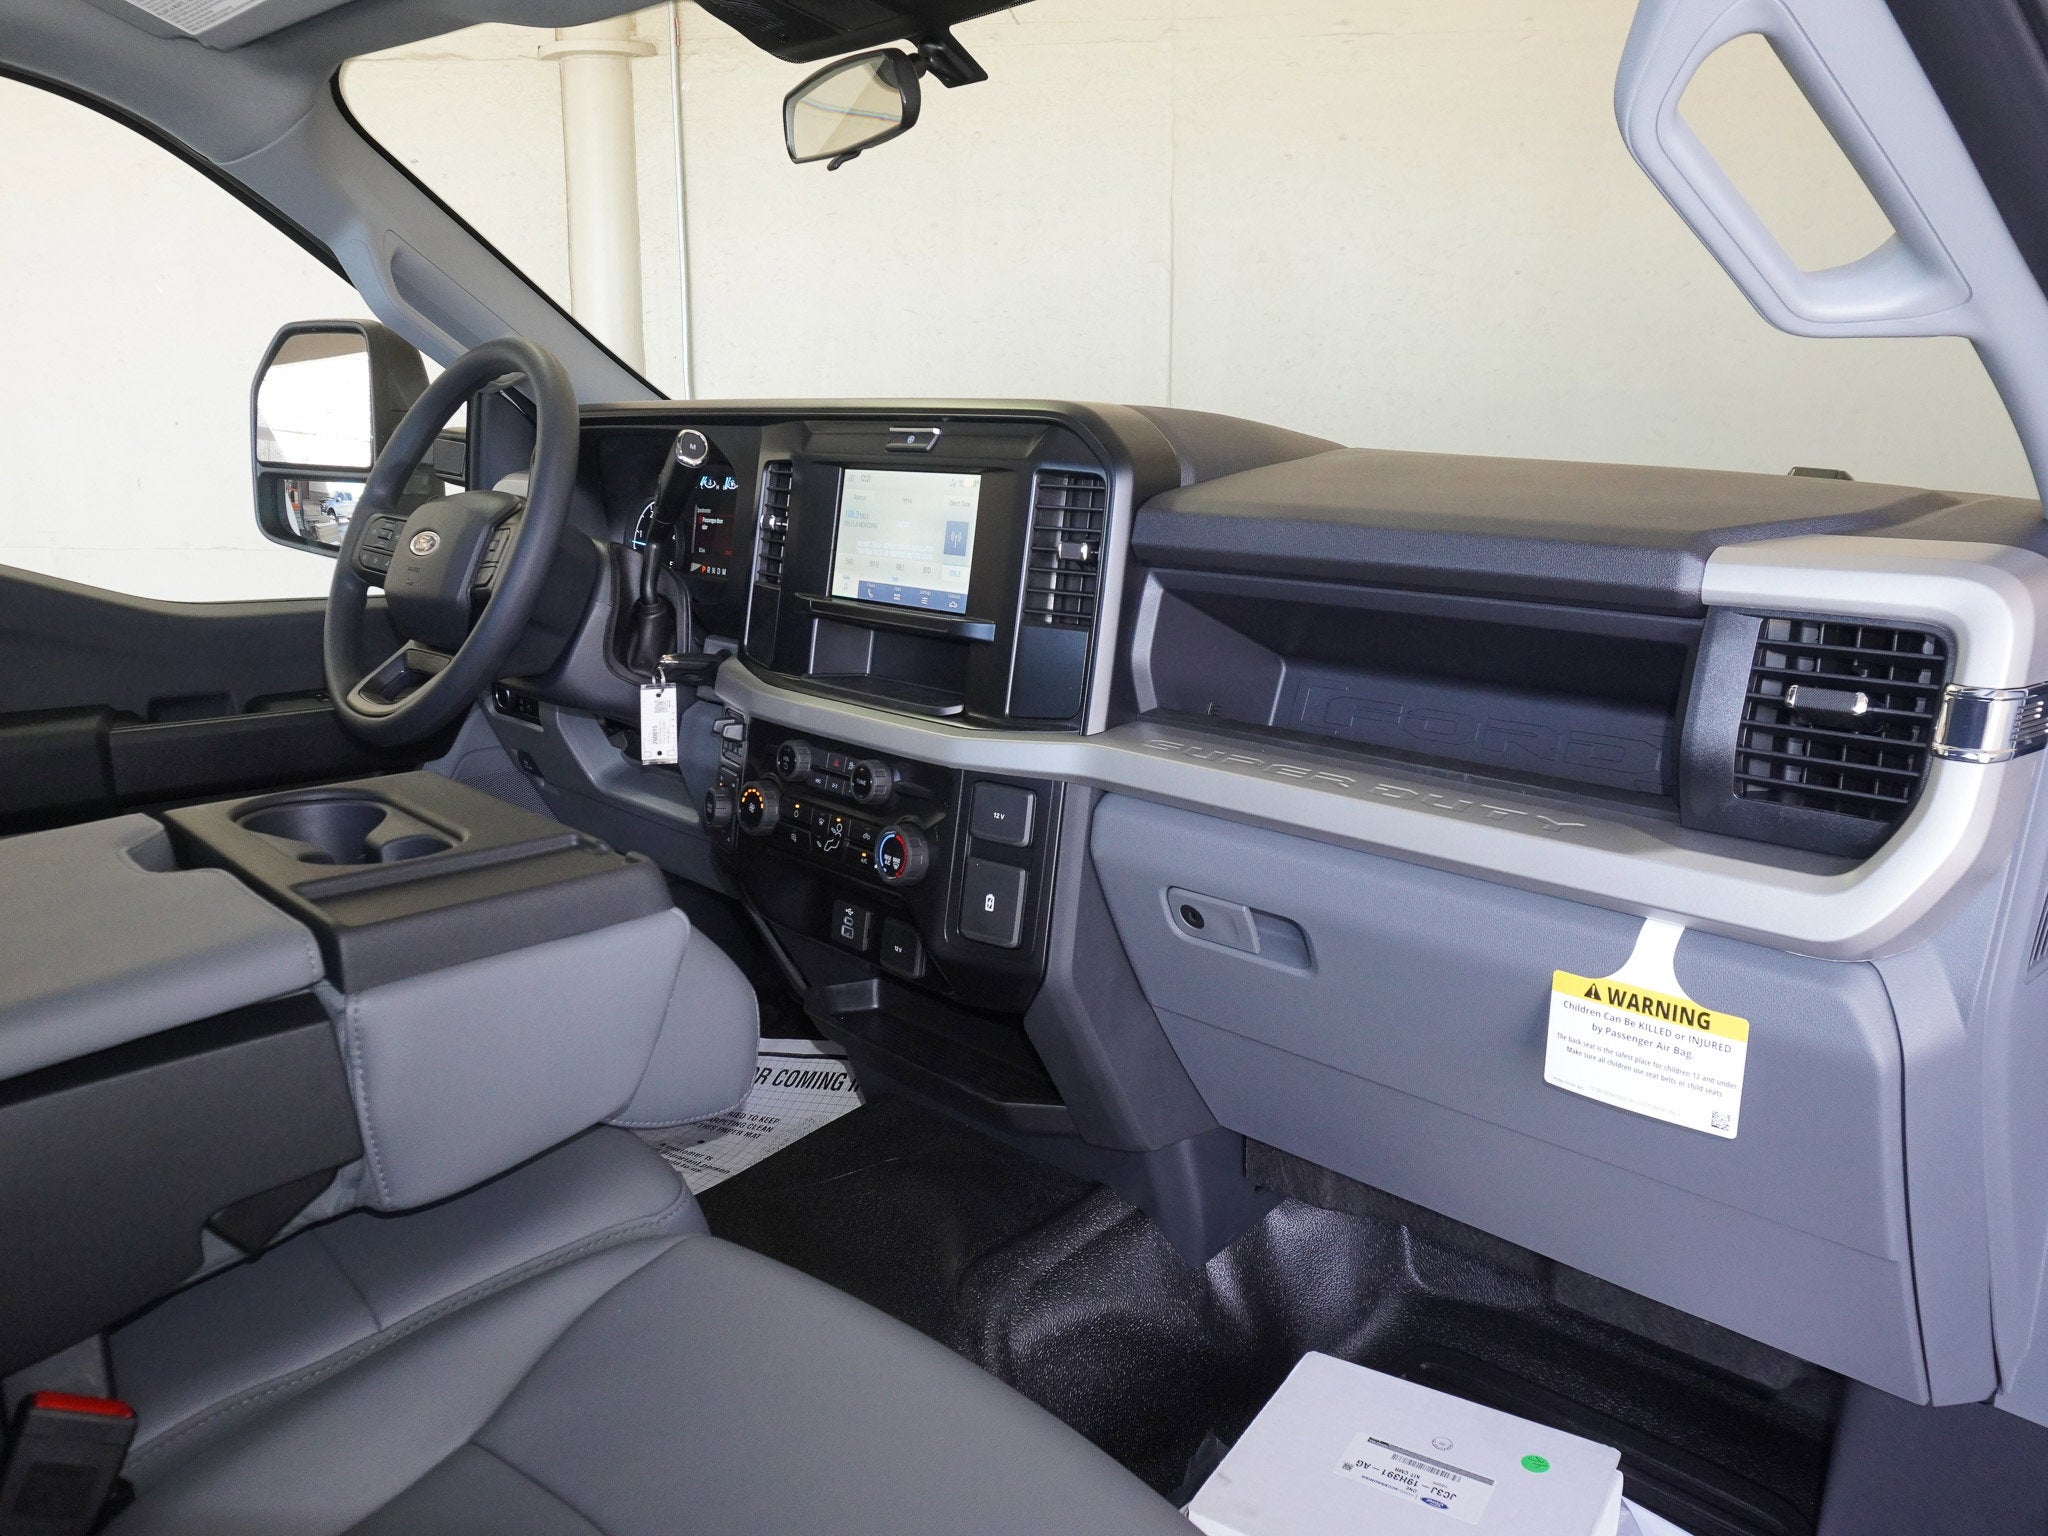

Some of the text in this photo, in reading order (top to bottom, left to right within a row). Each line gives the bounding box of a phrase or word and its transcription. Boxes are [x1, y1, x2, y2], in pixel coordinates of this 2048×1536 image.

[1142, 738, 1587, 833] SUPER DUTY
[1607, 986, 1711, 1030] WARNING
[1563, 1000, 1732, 1053] Children Can Be KILLED or INJURED
[1591, 1022, 1603, 1035] by
[1605, 1027, 1654, 1047] Passenger
[1656, 1042, 1671, 1052] Air
[1557, 1031, 1568, 1041] The
[1568, 1035, 1582, 1045] back
[1583, 1041, 1596, 1049] seat
[1596, 1044, 1602, 1052] is
[1603, 1047, 1614, 1055] the
[1615, 1050, 1634, 1061] safest
[1634, 1056, 1651, 1066] place
[1652, 1060, 1663, 1070] for
[1663, 1064, 1691, 1077] children
[1692, 1071, 1701, 1080] 12
[1701, 1075, 1715, 1084] and
[1566, 1045, 1582, 1056] Make
[1583, 1052, 1597, 1060] sure
[1597, 1056, 1606, 1064] all
[1606, 1059, 1632, 1072] children
[1633, 1067, 1644, 1075] use
[1645, 1071, 1659, 1079] seat
[1660, 1074, 1676, 1085] belts
[1687, 1082, 1704, 1092] child
[772, 1069, 848, 1092] COMING
[724, 1111, 746, 1120] RIED
[759, 1115, 780, 1124] KEEP
[747, 1123, 773, 1132] CLEAN
[743, 1131, 762, 1139] MAT
[1355, 1459, 1372, 1470] AG
[1381, 1469, 1418, 1487] 19H391
[1430, 1486, 1457, 1501] JC3J
